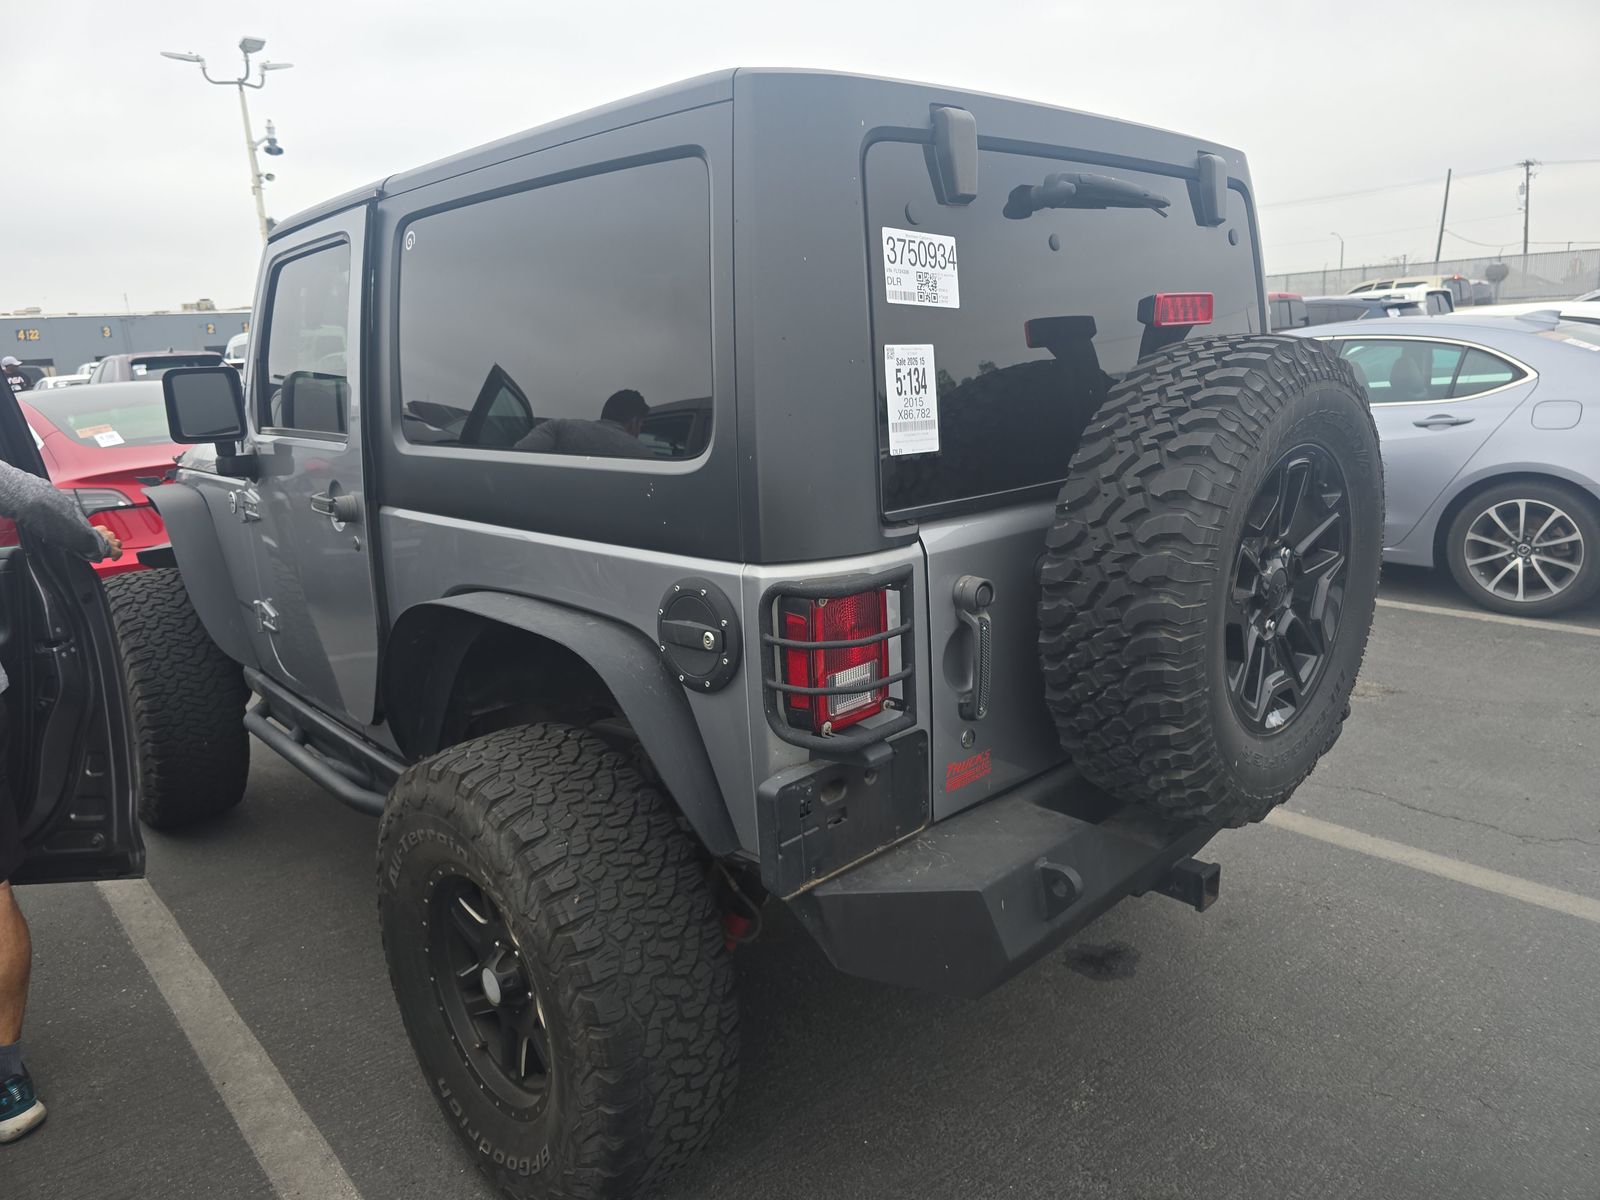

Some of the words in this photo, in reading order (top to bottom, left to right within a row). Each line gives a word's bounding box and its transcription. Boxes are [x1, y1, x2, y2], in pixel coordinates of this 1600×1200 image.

[886, 236, 957, 271] 3750934
[886, 276, 902, 286] DLR
[18, 329, 25, 340] 4
[103, 326, 111, 337] 3
[896, 358, 906, 367] Sale
[895, 367, 927, 397] 5:134
[903, 397, 924, 408] 2015
